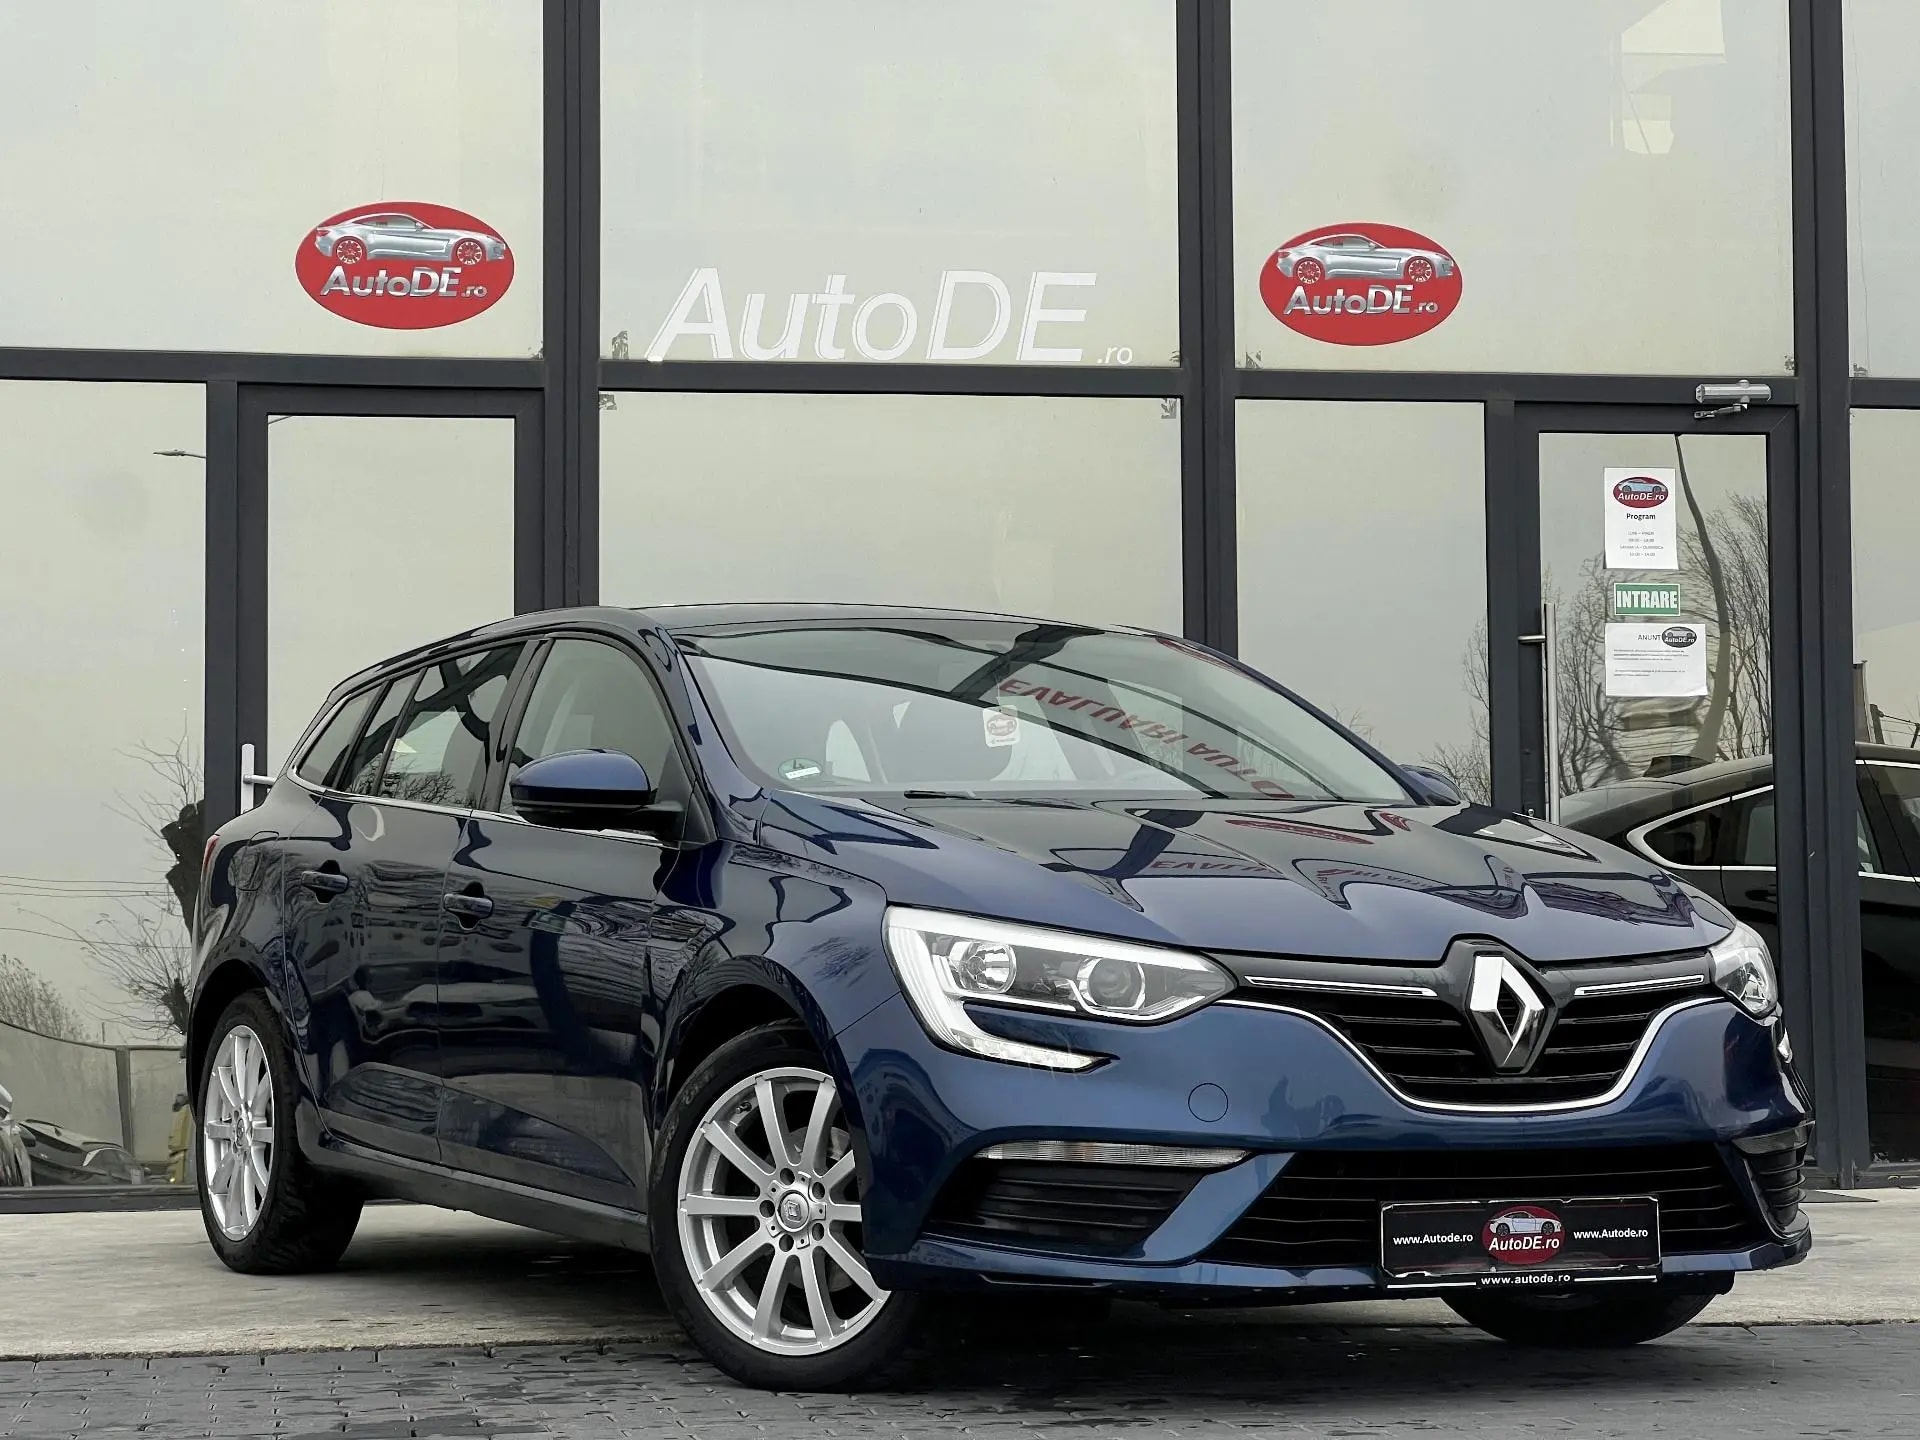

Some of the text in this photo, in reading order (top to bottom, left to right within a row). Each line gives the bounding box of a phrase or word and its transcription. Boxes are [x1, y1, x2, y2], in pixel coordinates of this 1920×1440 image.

[1617, 492, 1665, 501] AutoDE.ro
[1626, 512, 1656, 521] Program
[1616, 590, 1678, 609] INTRARE
[1393, 1232, 1474, 1246] www.Autode.ro
[1573, 1227, 1649, 1240] www.Autode.ro
[1488, 1235, 1560, 1251] AutoDE.ro
[1480, 1273, 1571, 1286] www.autode.ro
